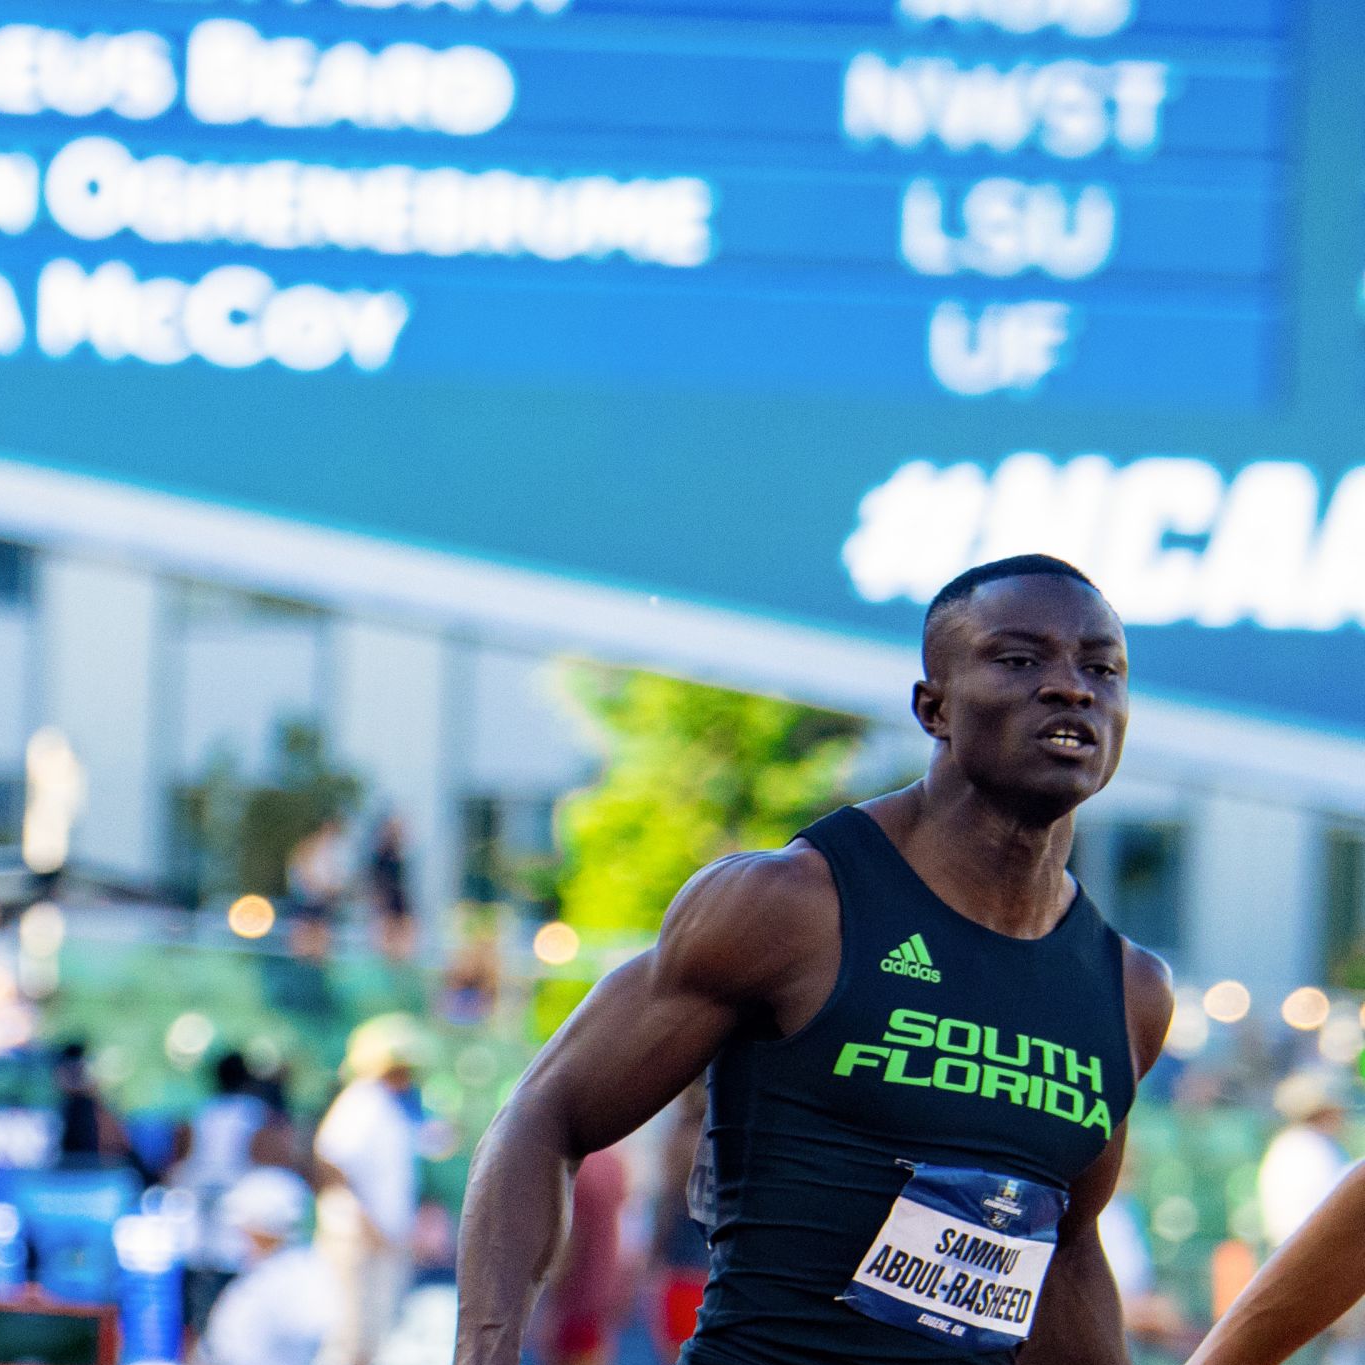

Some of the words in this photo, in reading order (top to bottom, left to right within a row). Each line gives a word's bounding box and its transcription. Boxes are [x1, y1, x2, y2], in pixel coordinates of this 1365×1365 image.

[843, 52, 1169, 158] NWST
[901, 177, 1116, 278] LSU
[928, 299, 1070, 396] UF
[879, 956, 942, 984] adidas
[833, 1042, 1112, 1140] FLORIDA
[882, 1008, 1103, 1094] SOUTH
[866, 1244, 1033, 1324] ABDUL-RASHEED
[934, 1228, 1021, 1275] SAMINU
